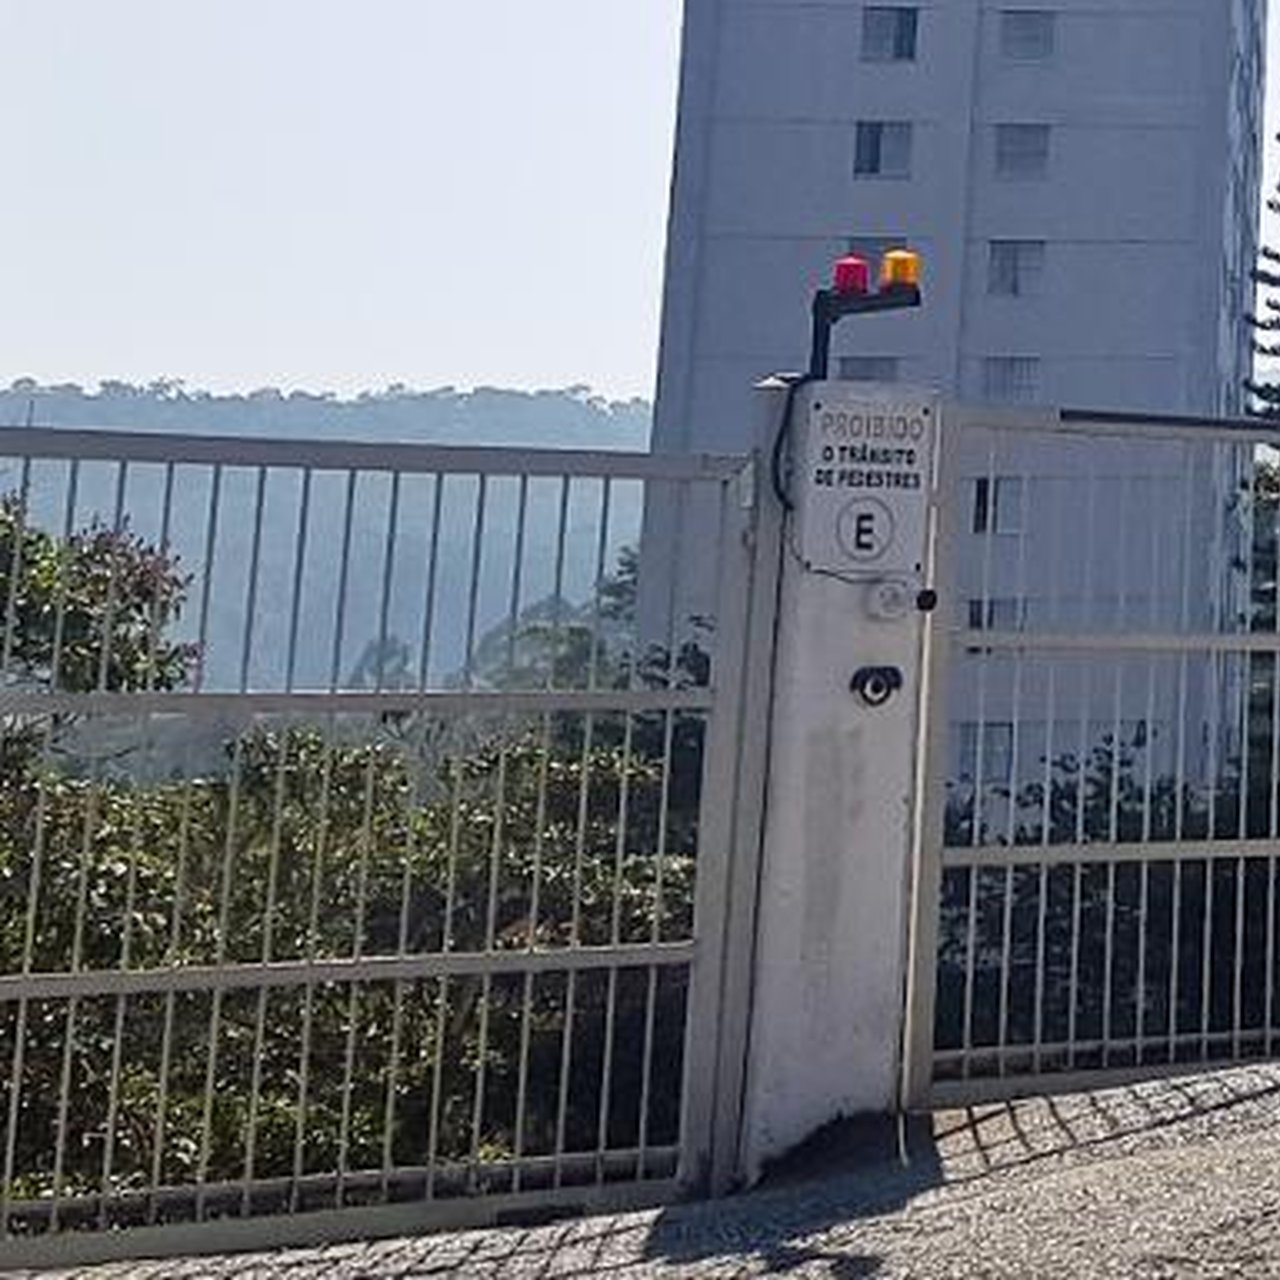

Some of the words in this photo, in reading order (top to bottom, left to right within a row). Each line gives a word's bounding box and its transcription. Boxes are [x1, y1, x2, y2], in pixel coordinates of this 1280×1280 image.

[822, 412, 924, 441] PROIBIDO
[822, 445, 833, 462] O
[838, 443, 917, 465] TRÂNSITO
[815, 469, 833, 487] DE
[837, 470, 921, 489] PEDESTRES
[854, 513, 874, 550] E
